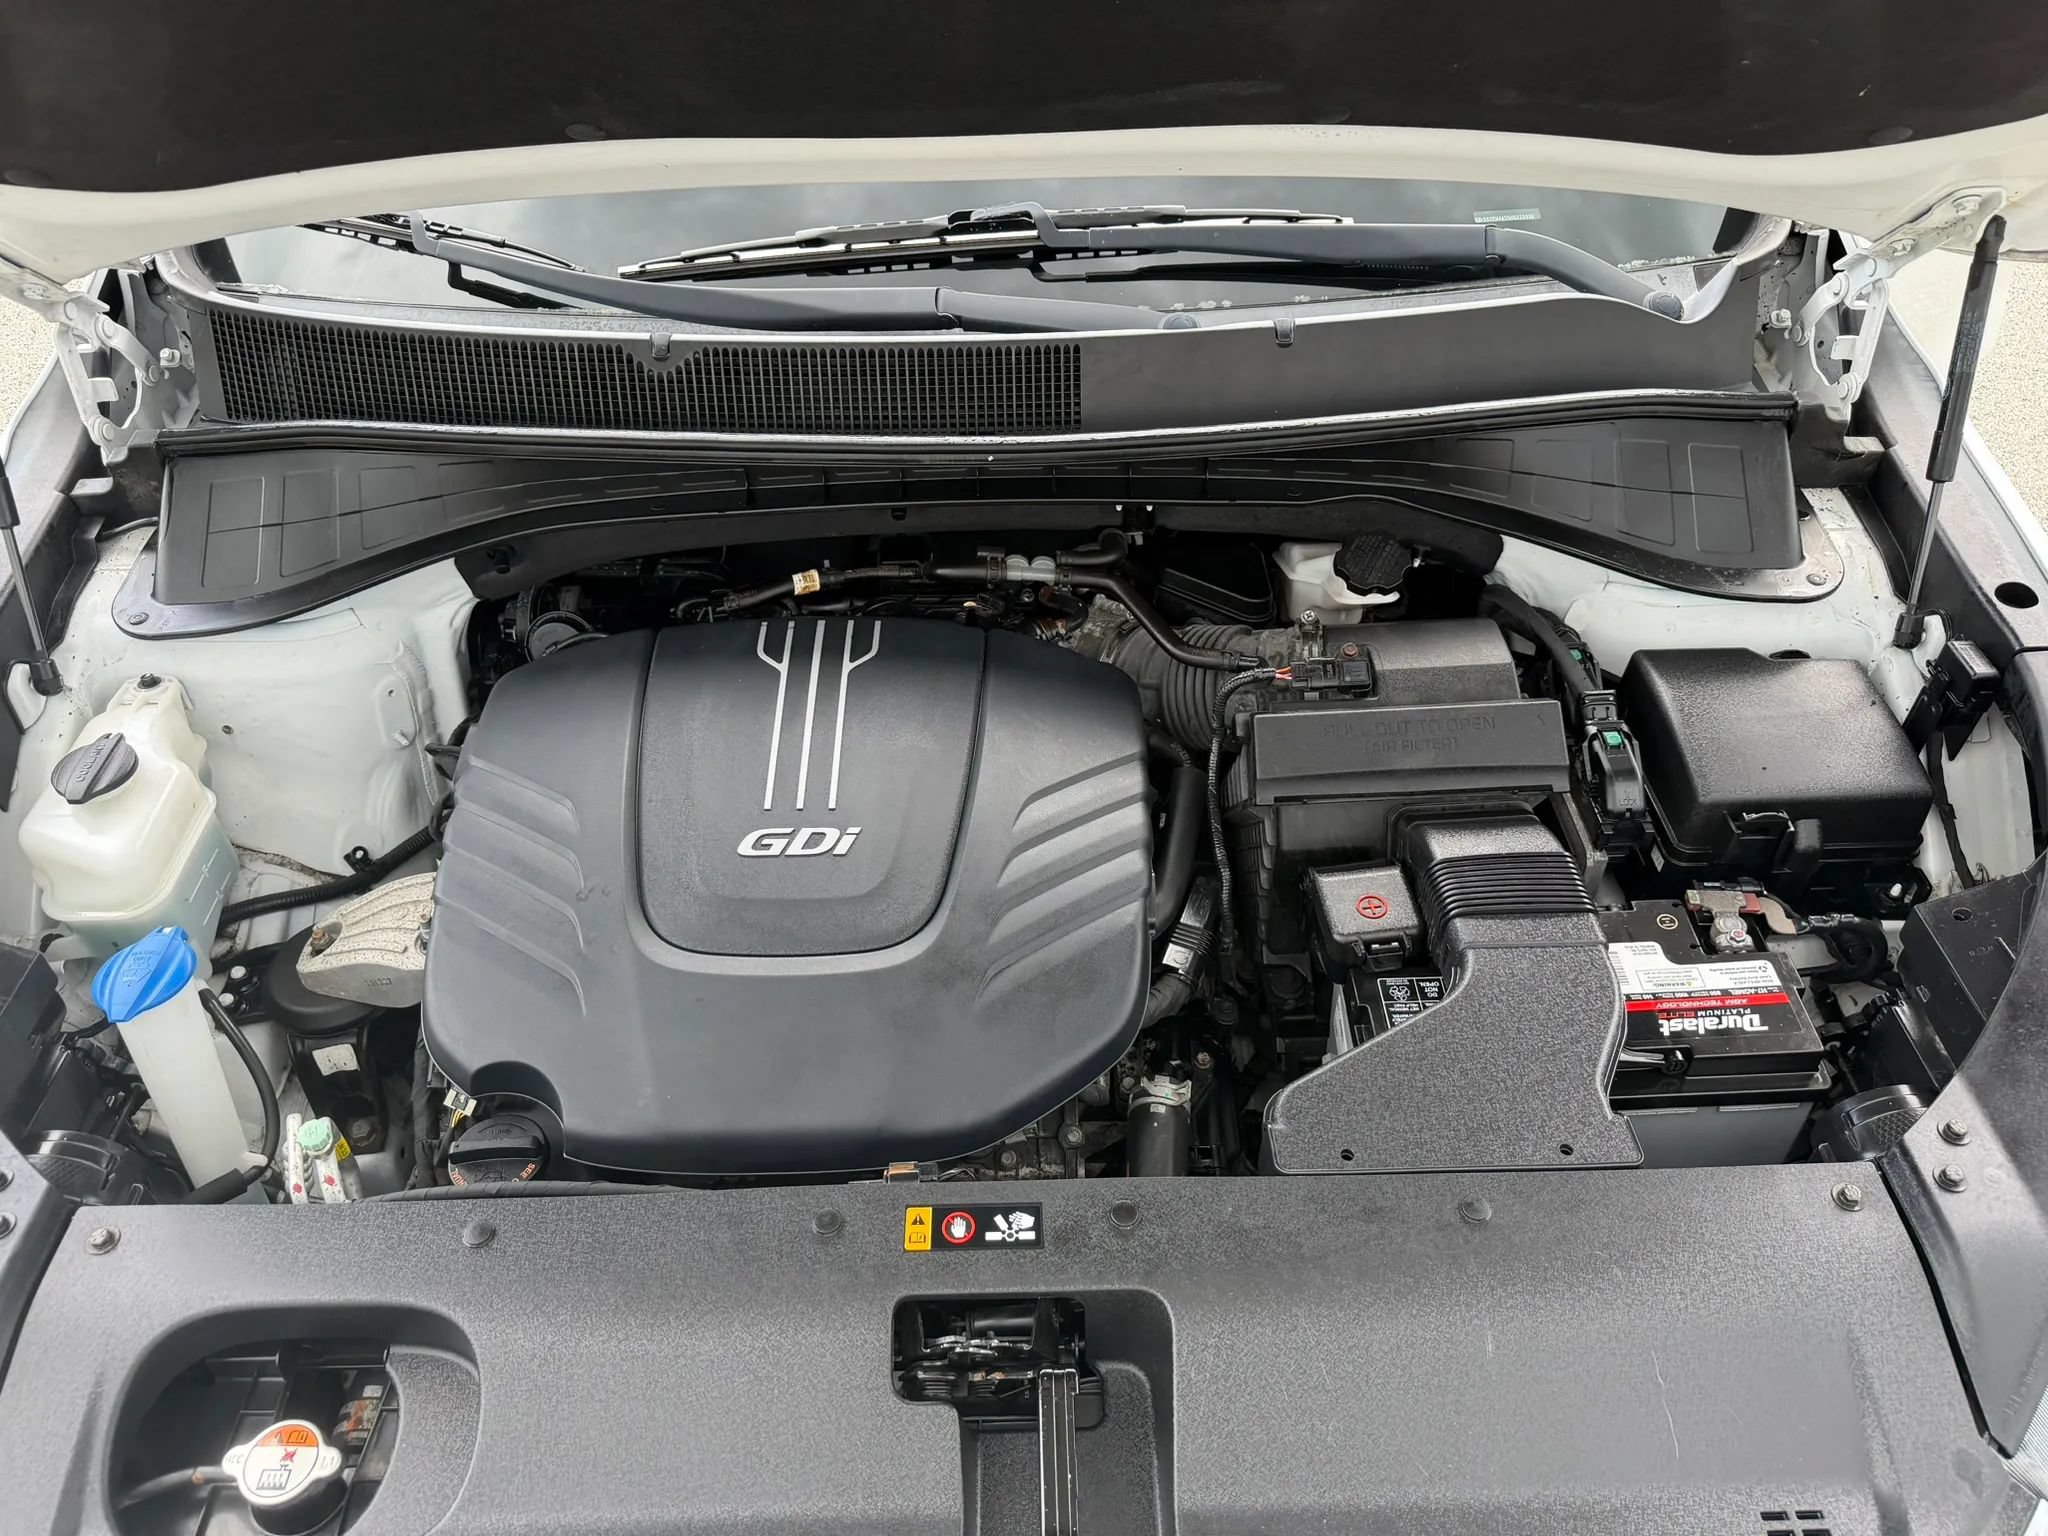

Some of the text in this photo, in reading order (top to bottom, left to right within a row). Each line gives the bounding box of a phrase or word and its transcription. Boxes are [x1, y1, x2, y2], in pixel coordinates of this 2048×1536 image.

[1375, 720, 1411, 736] OUT
[1416, 719, 1440, 734] TO
[1446, 716, 1497, 732] OPEN
[736, 826, 863, 858] GDi
[1656, 1000, 1722, 1009] TECHNOLOGY
[1697, 1007, 1751, 1016] PLATINUM
[1659, 1014, 1769, 1036] Duralast
